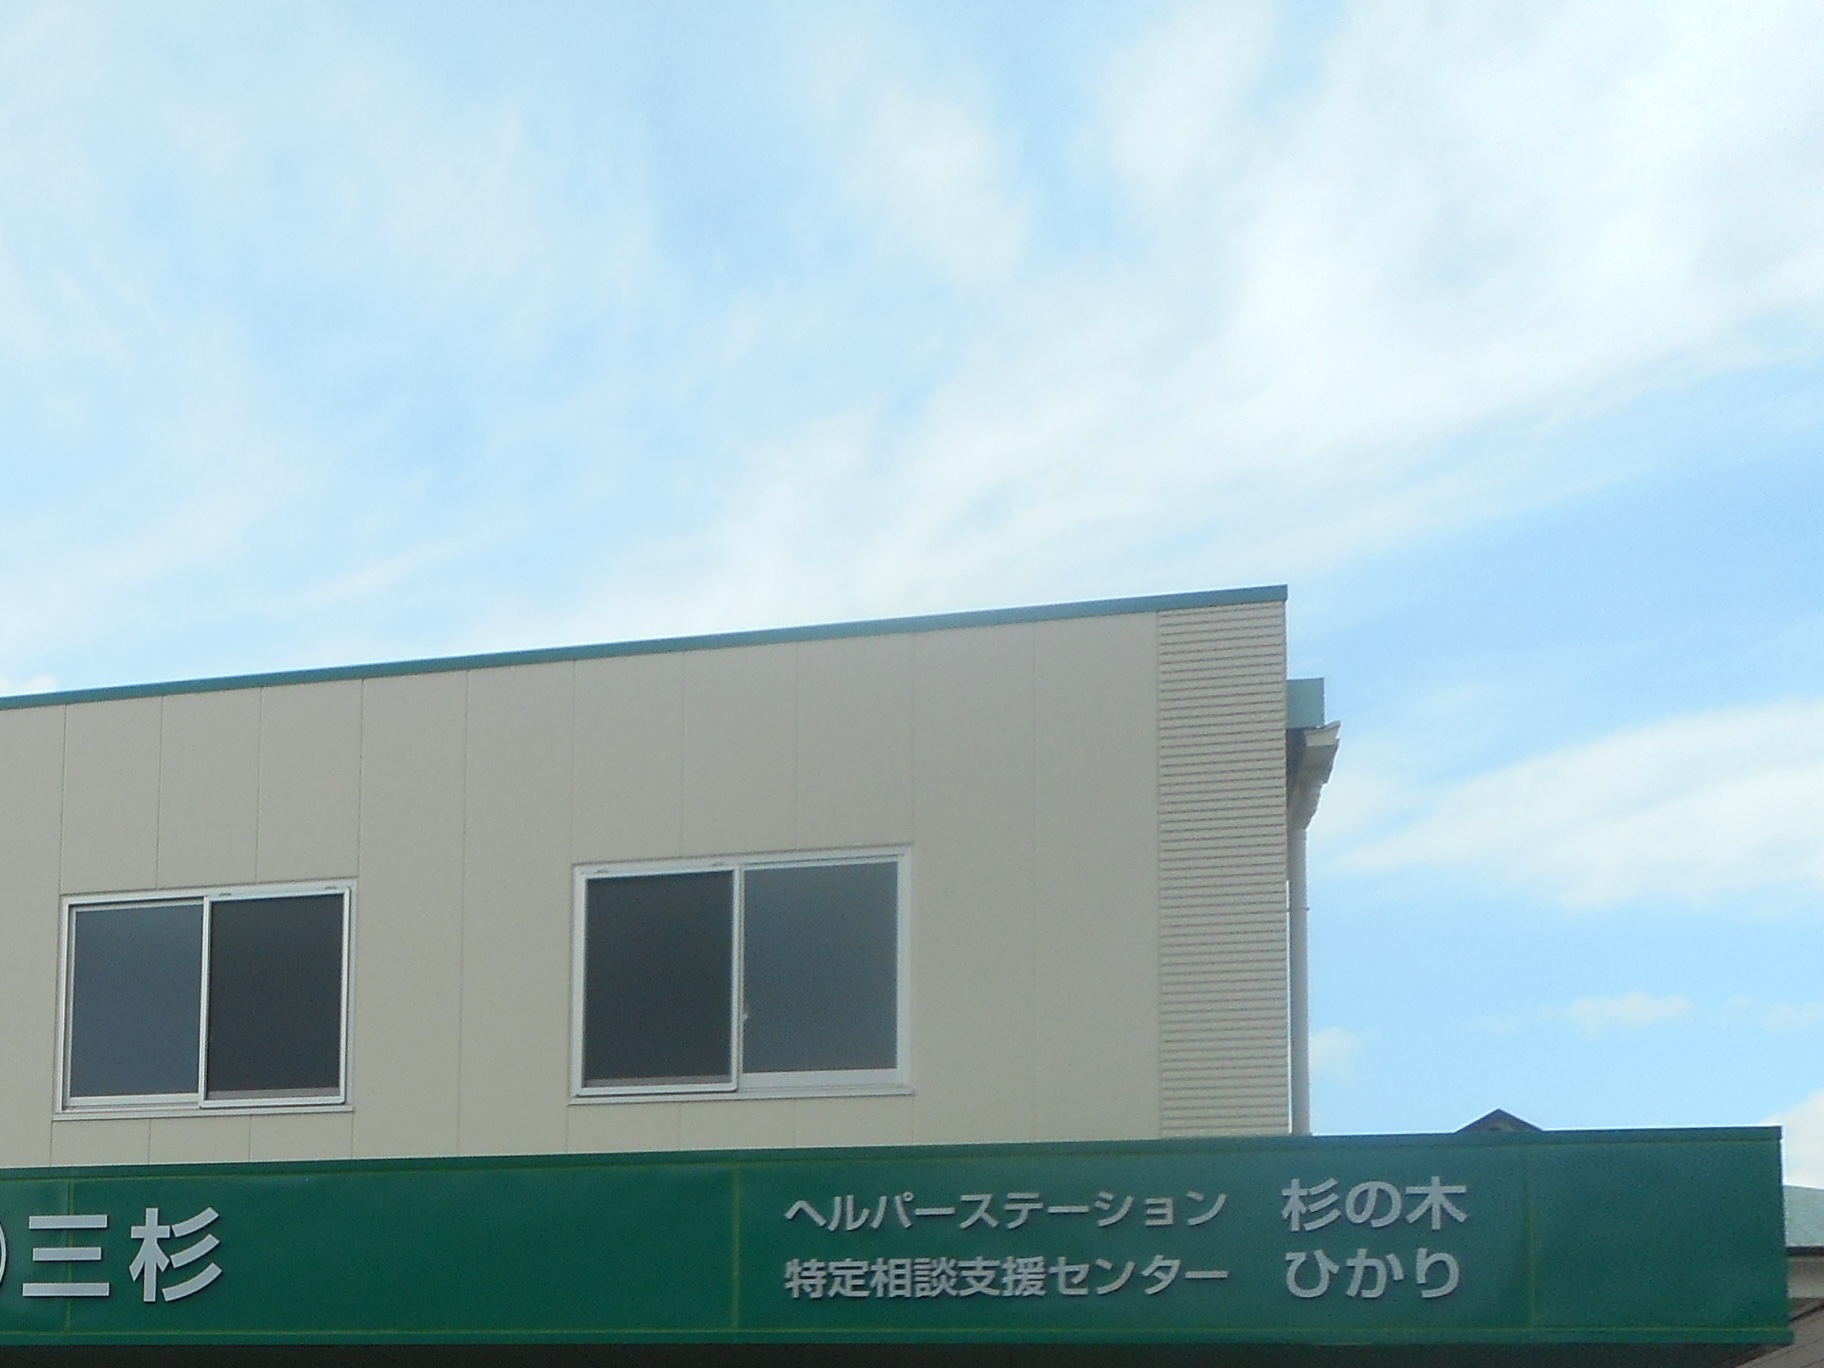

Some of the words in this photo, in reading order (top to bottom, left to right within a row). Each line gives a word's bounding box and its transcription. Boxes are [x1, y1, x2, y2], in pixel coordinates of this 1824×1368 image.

[784, 1190, 1228, 1232] ヘルパーステーション
[1281, 1176, 1468, 1232] 杉の木
[784, 1255, 1229, 1298] 特定相談支援センター
[1284, 1247, 1460, 1299] ひかり
